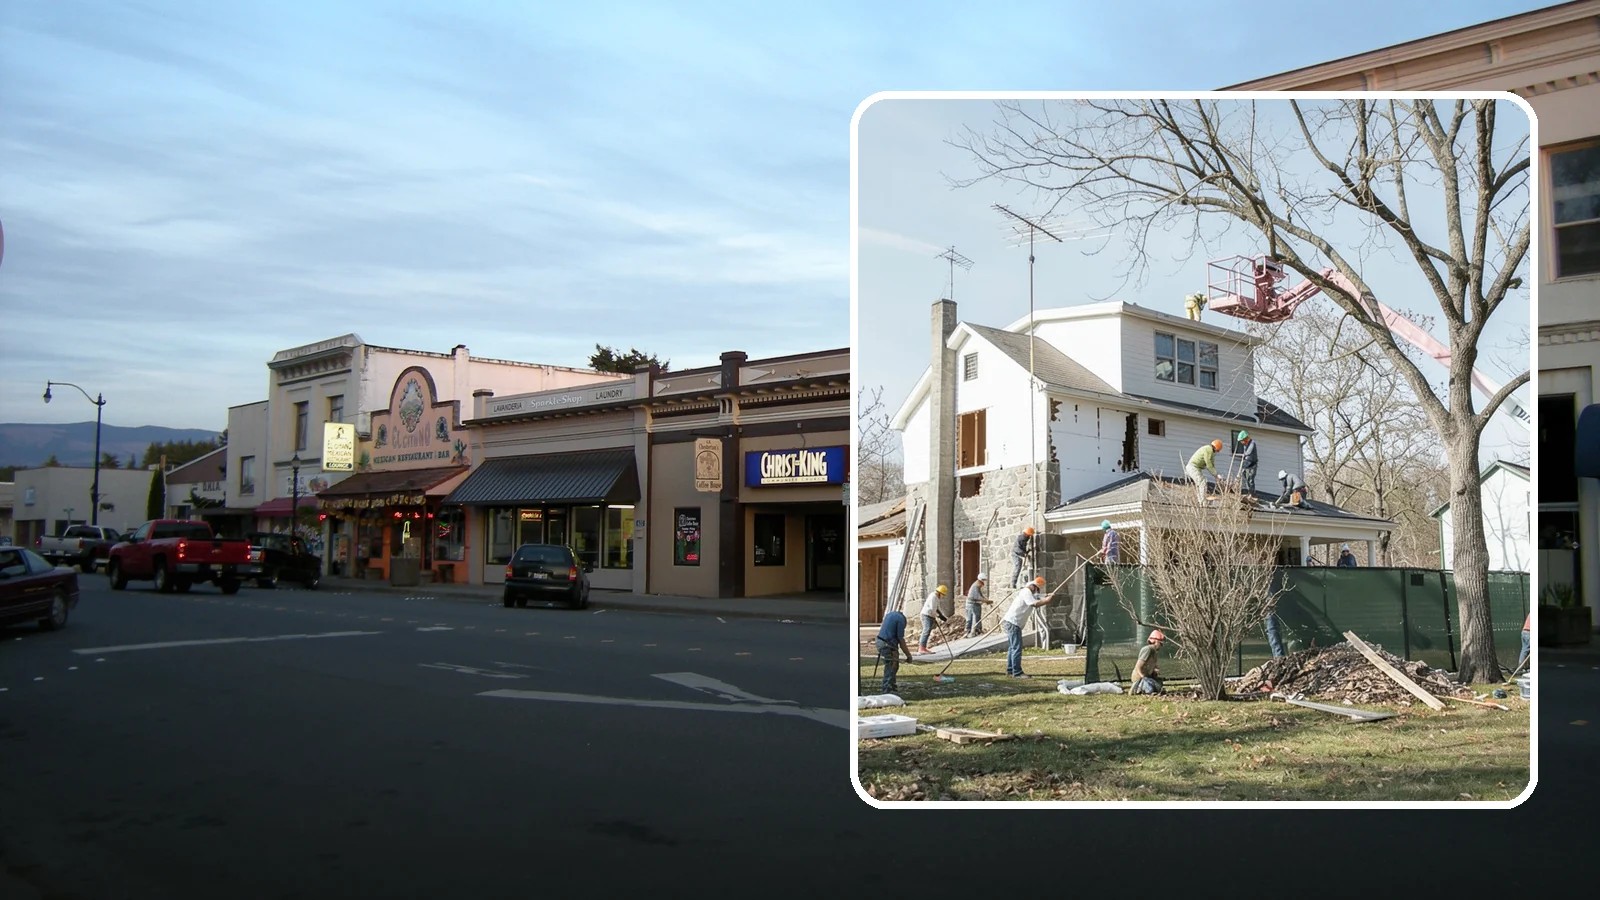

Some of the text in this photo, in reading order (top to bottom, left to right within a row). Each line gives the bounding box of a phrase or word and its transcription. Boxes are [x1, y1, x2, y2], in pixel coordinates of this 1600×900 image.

[493, 388, 623, 413] LAVANDERIA Sparkle Shop LAUNDRY
[373, 454, 396, 464] MEXICAN
[397, 451, 433, 463] RESTAURANT
[437, 450, 450, 459] BAR
[760, 452, 797, 478] CHRIST
[798, 449, 827, 476] KING
[696, 480, 709, 489] Coffee
